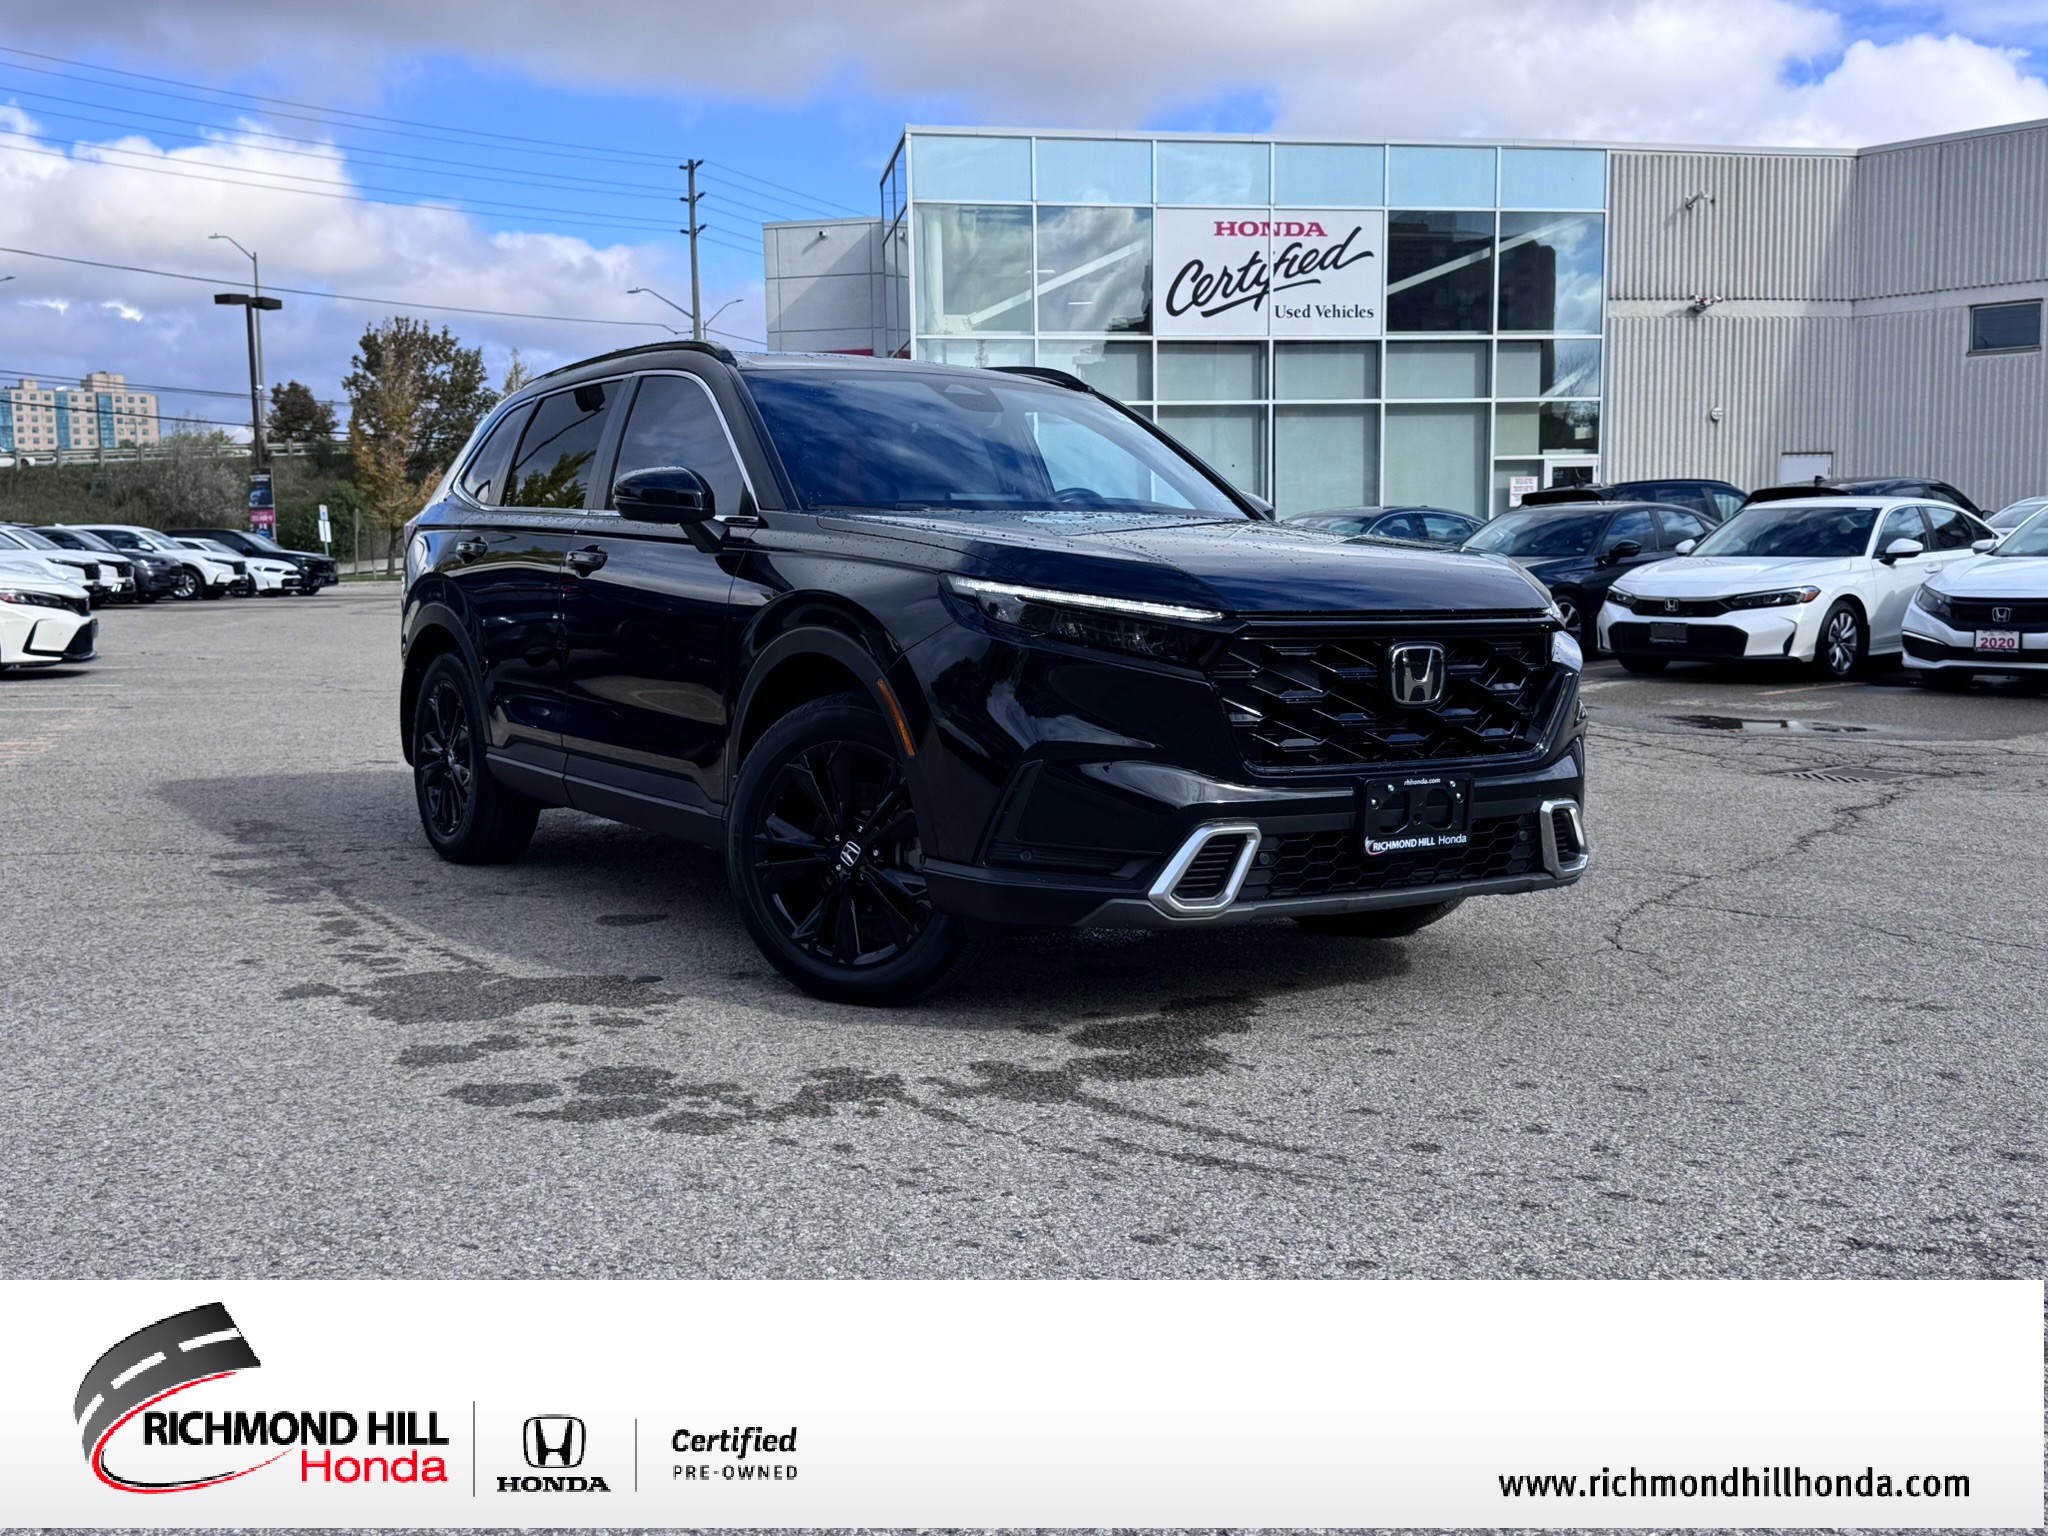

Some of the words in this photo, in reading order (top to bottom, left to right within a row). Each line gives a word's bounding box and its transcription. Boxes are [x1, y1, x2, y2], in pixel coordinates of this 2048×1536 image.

[1213, 221, 1328, 237] HONDA
[1166, 226, 1374, 317] Certified
[1274, 304, 1311, 318] Used
[1315, 304, 1374, 318] Vehicles
[1980, 637, 2015, 649] 2020
[1372, 838, 1417, 851] RICHMOND
[1418, 837, 1435, 847] HILL
[1438, 833, 1467, 845] Honda
